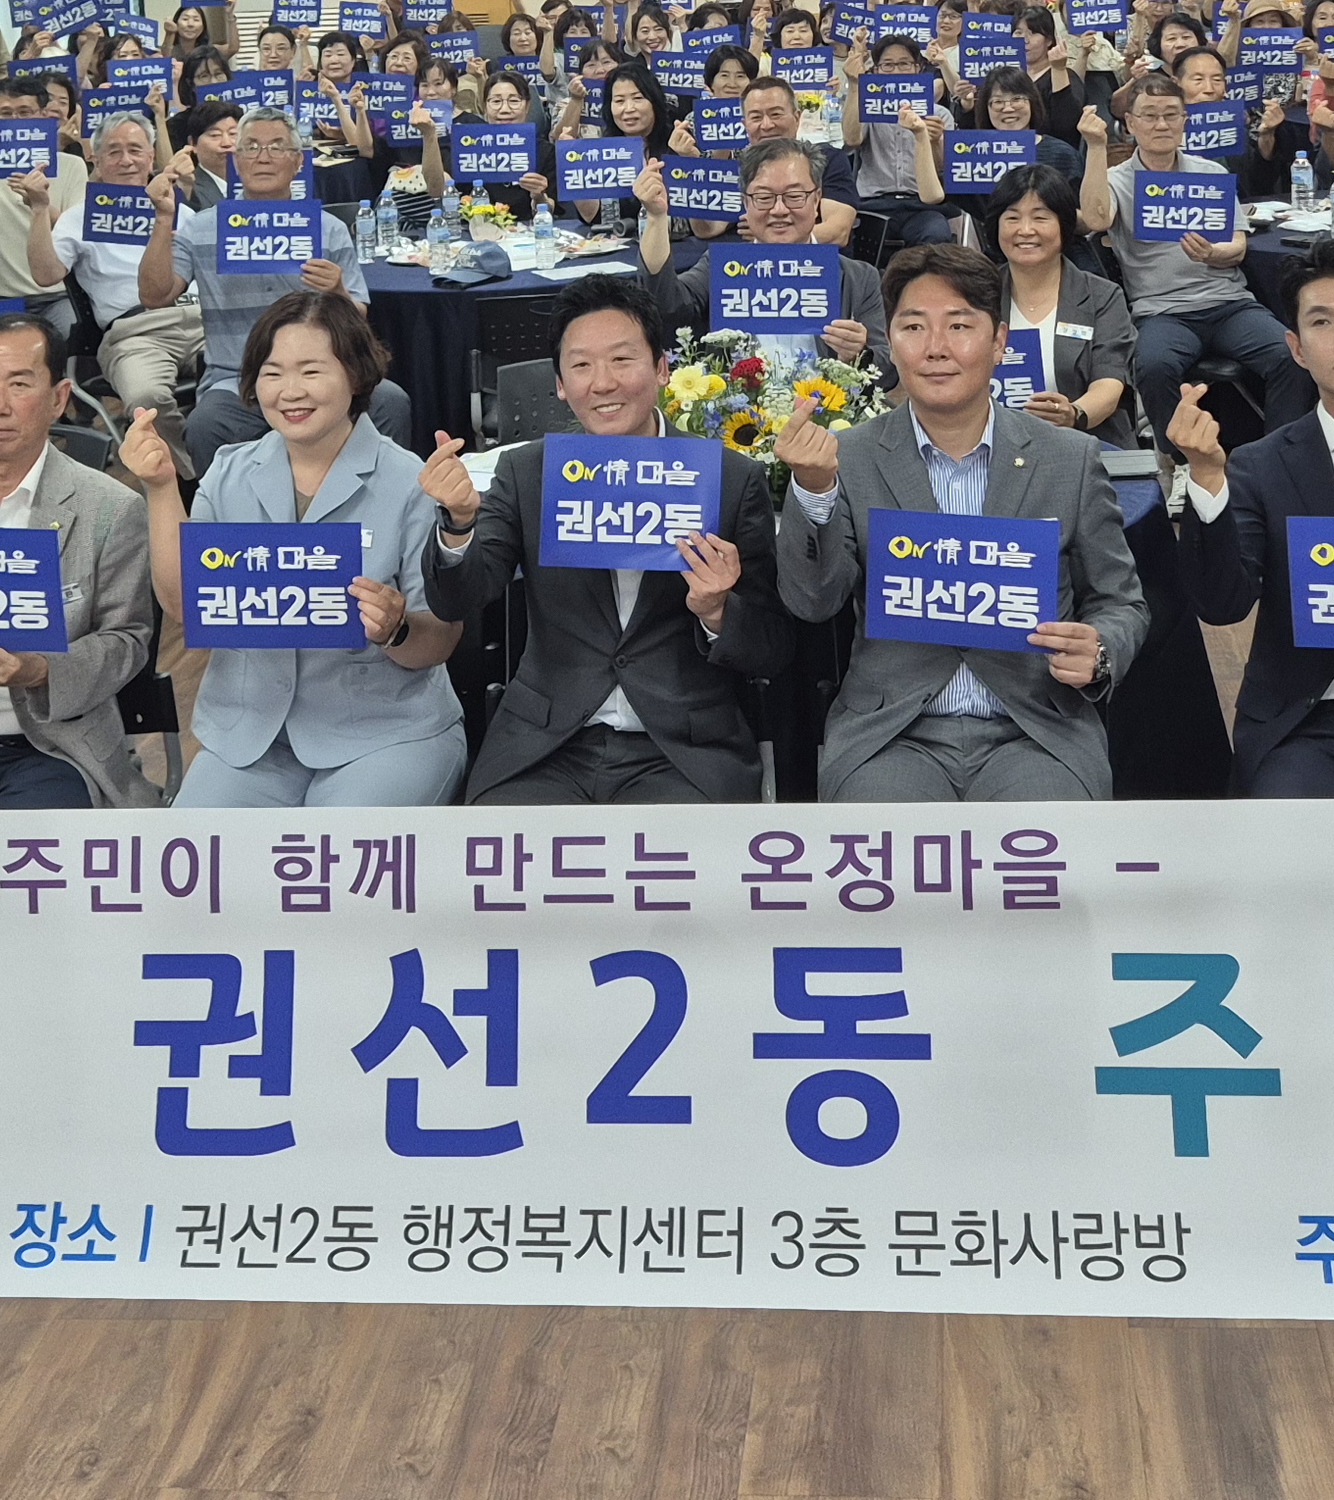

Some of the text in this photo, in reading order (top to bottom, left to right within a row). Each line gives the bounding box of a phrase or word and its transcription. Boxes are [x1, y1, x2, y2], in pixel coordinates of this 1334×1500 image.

[42, 0, 98, 36] 권선2동
[1070, 8, 1123, 27] 권선2동
[1239, 49, 1299, 66] 권선2동
[775, 67, 830, 85] 권선2동
[458, 151, 531, 175] 권선2동
[563, 166, 638, 190] 권선2동
[667, 186, 743, 214] 권선2동
[1140, 205, 1228, 231] 권선2동
[224, 236, 314, 261] 권선2동
[720, 287, 830, 318] 권선2동
[555, 500, 704, 545] 권선2동
[197, 585, 349, 626] 권선2동
[881, 575, 1042, 630] 권선2동
[271, 832, 418, 914] 함께
[464, 831, 698, 912] 만드는
[739, 829, 1068, 913] 온정마을
[132, 946, 933, 1168] 권선2동
[9, 1200, 1193, 1283] 장소 권선2동 행정복지센터 3층 문화사랑방
